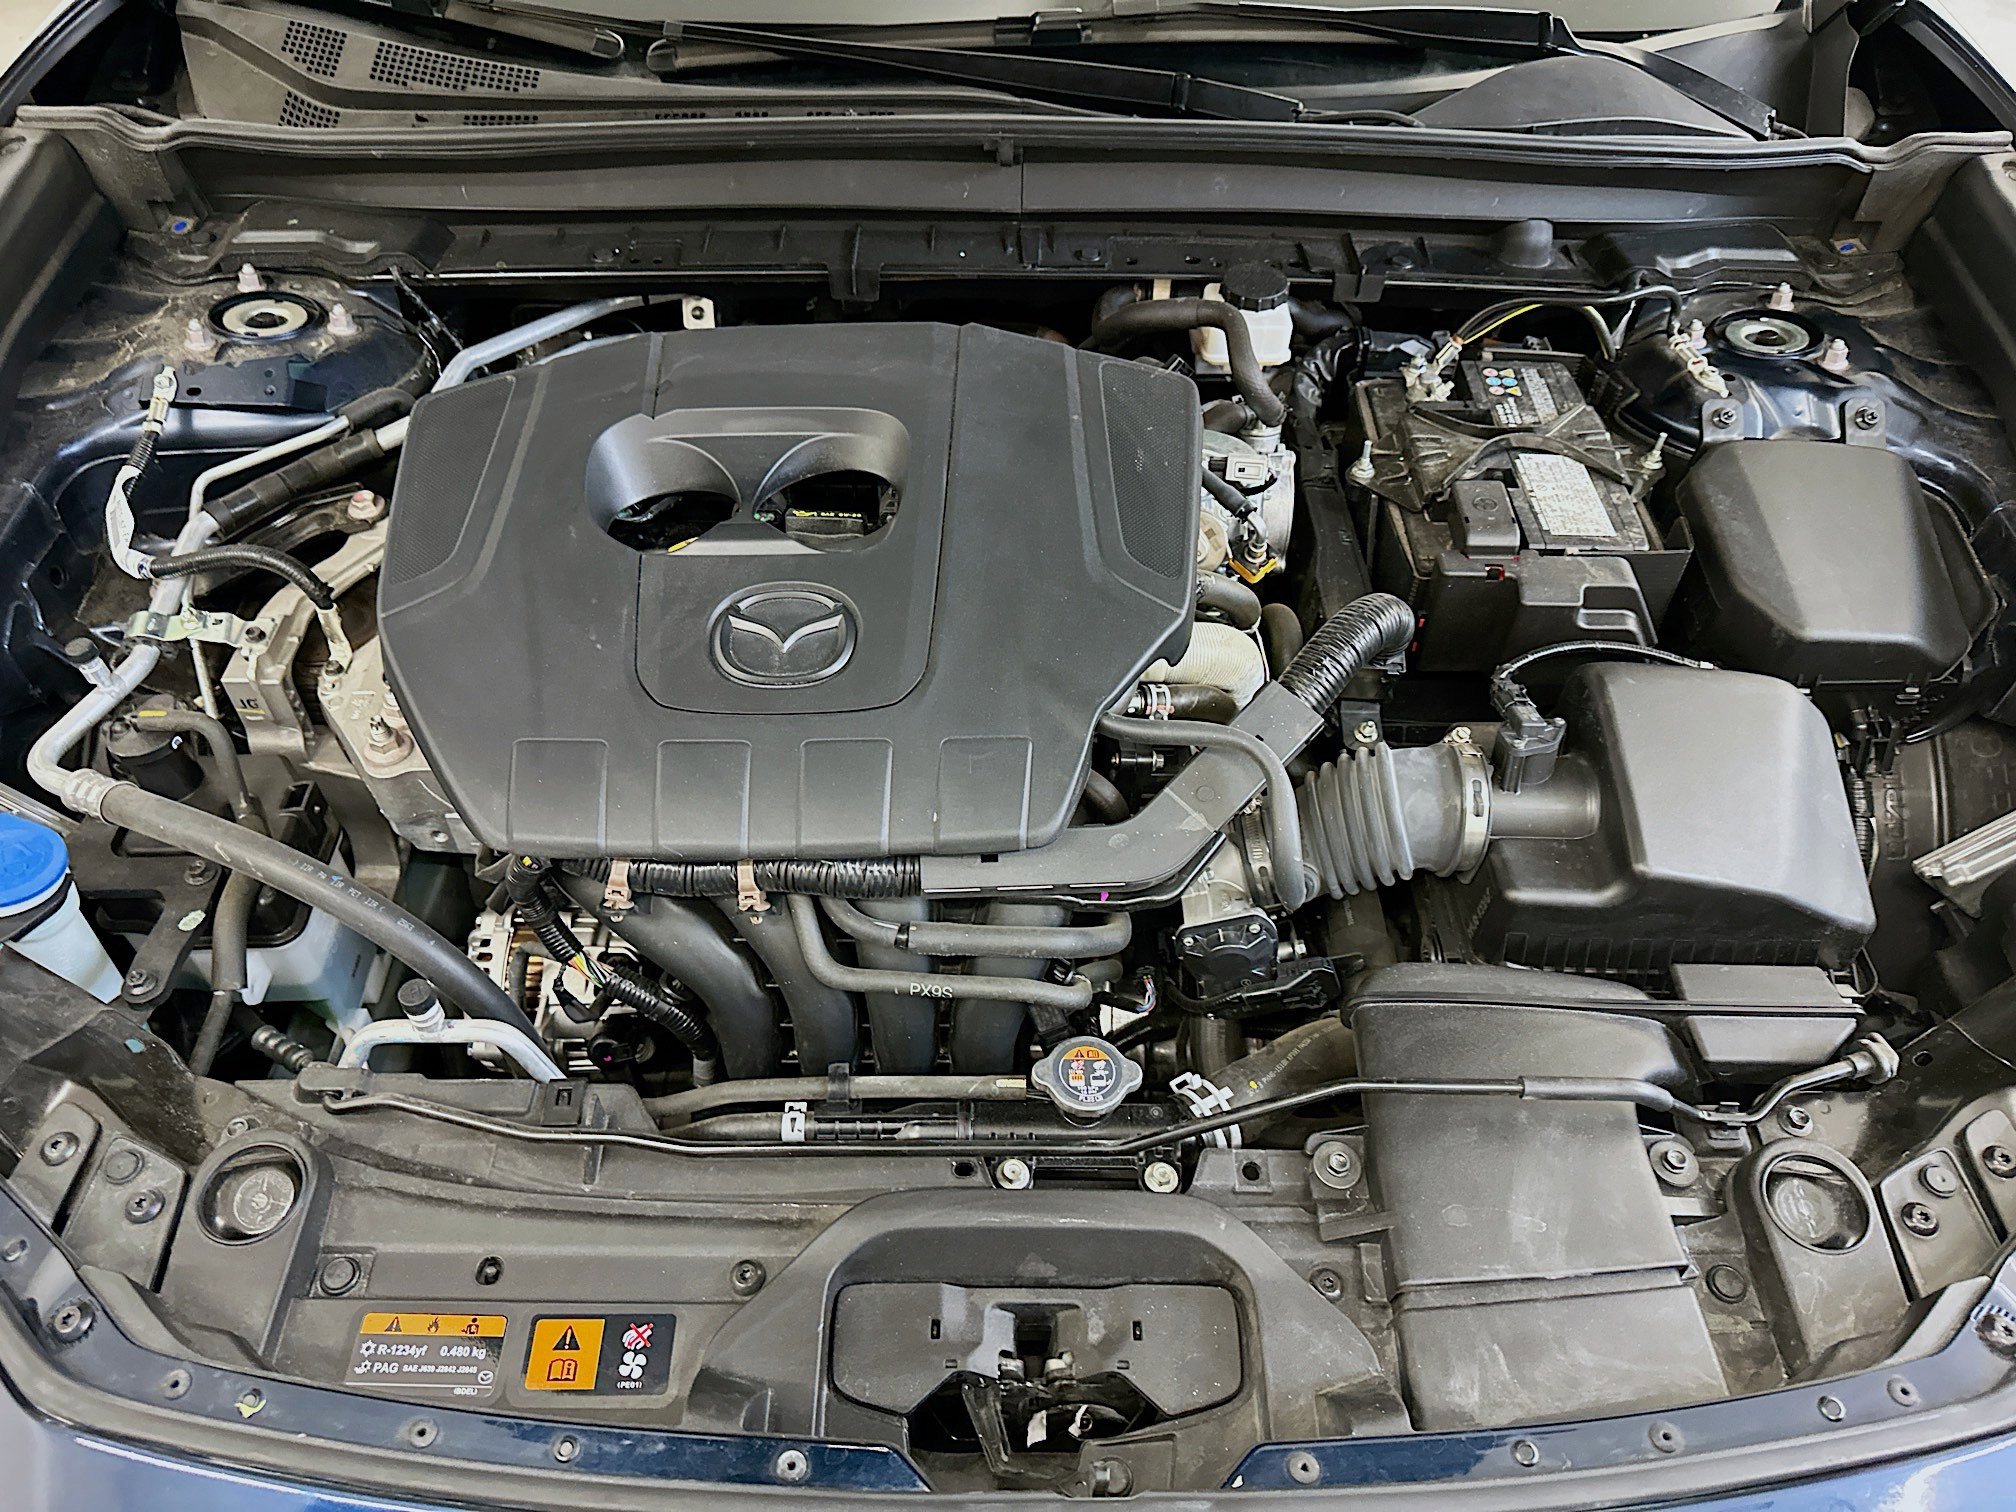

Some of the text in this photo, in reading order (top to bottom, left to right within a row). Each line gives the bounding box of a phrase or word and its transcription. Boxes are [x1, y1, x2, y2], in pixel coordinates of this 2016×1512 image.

[909, 982, 953, 998] PX9S
[376, 1344, 428, 1358] R-1234yf
[471, 1348, 487, 1360] kg
[372, 1362, 399, 1374] PAG
